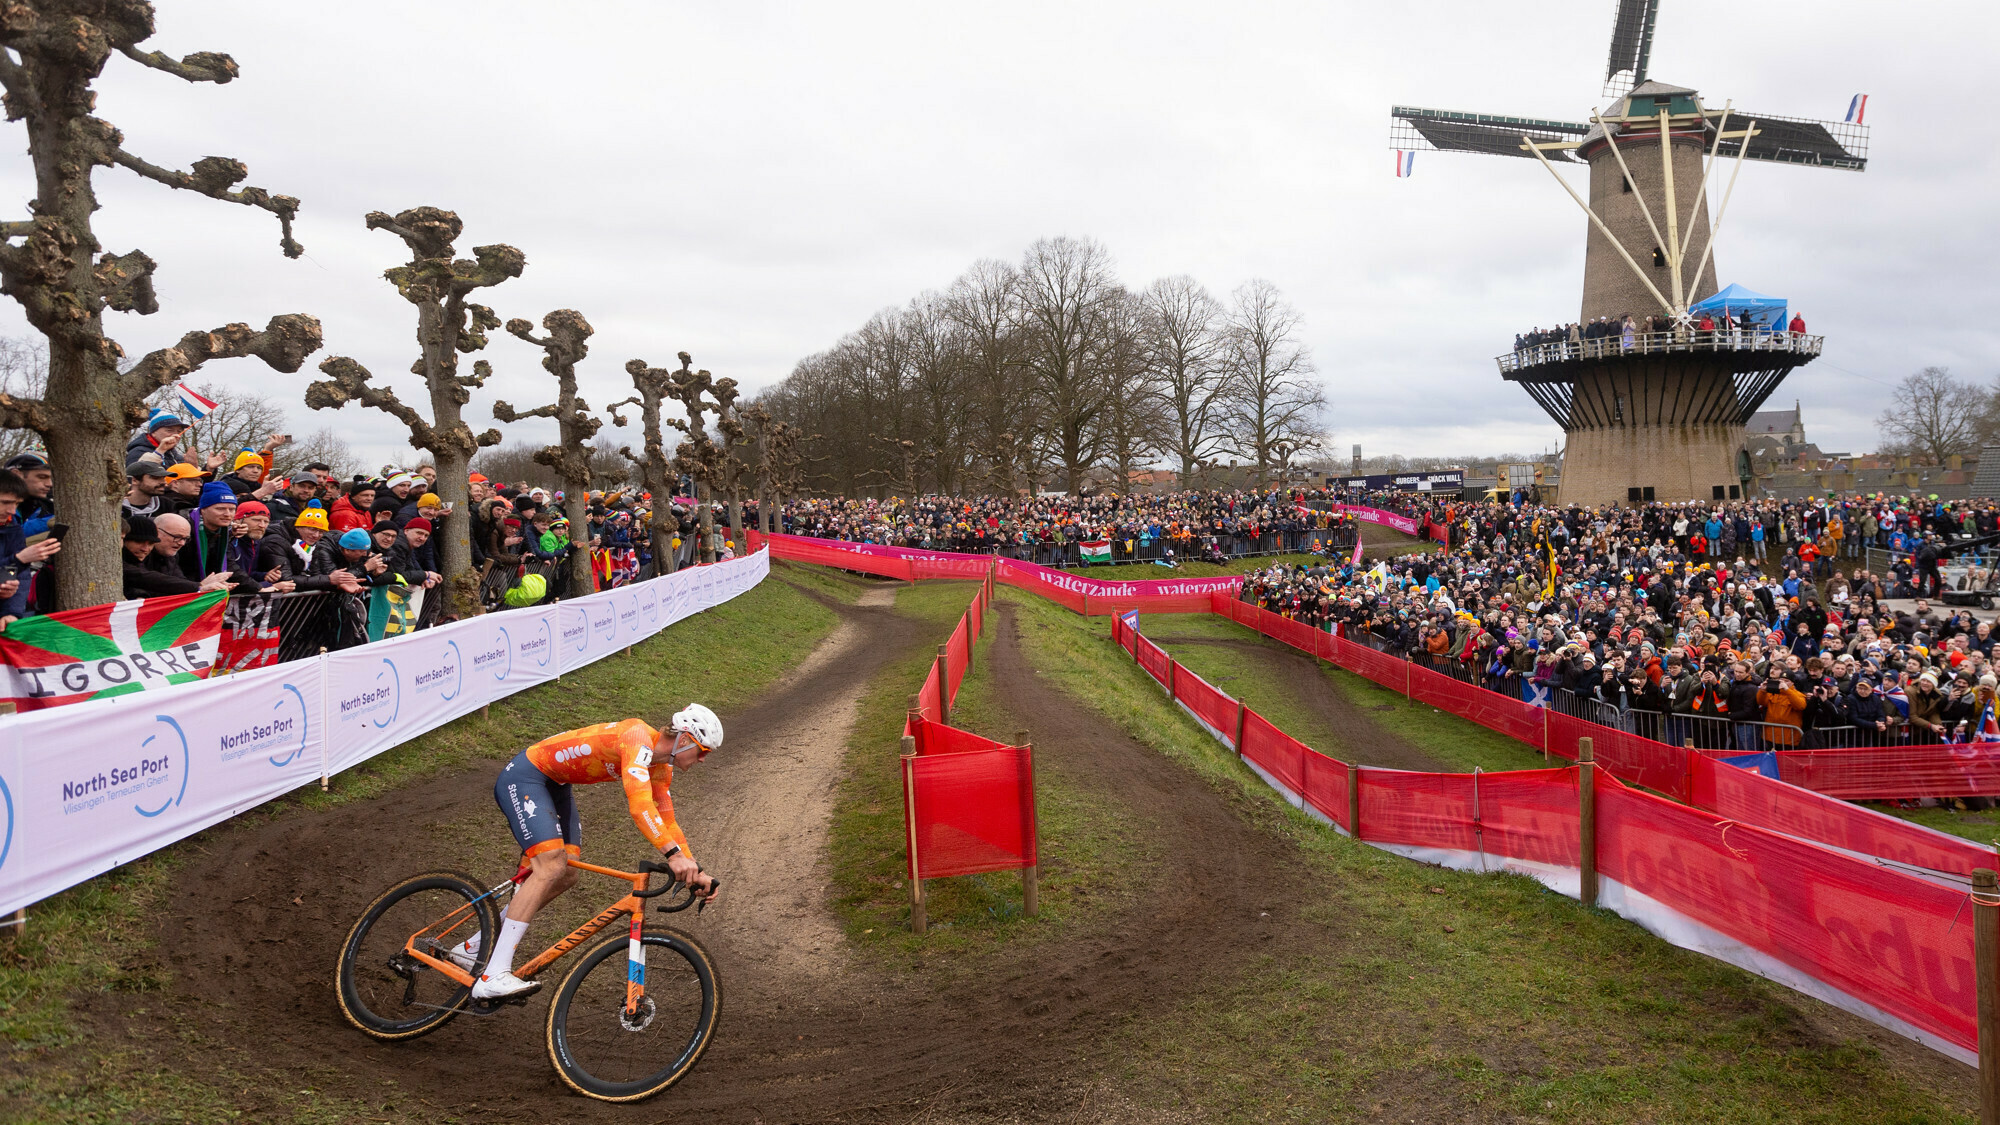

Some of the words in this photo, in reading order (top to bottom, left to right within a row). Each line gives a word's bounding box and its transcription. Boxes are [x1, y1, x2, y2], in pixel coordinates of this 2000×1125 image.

[1348, 479, 1367, 487] DRINKS
[1396, 476, 1420, 484] BURGERS
[1427, 474, 1446, 483] SNACK
[1446, 474, 1461, 482] WALL
[1039, 571, 1137, 597] waterzande
[1157, 577, 1244, 596] waterzande
[539, 638, 547, 647] Port
[473, 653, 487, 665] North
[487, 651, 496, 661] Sea
[496, 649, 505, 658] Port
[18, 642, 210, 698] IGORRE
[415, 671, 431, 686] North
[432, 668, 442, 680] Sea
[443, 665, 454, 676] Port
[340, 694, 361, 713] North
[362, 690, 375, 704] Sea
[376, 686, 390, 700] Port
[220, 731, 250, 751] North
[252, 723, 271, 741] Sea
[273, 717, 293, 733] Port
[642, 752, 649, 762] 1
[63, 773, 107, 801] North
[110, 766, 138, 786] Sea
[141, 755, 169, 777] Port
[63, 793, 105, 815] Vlissingen
[106, 781, 146, 801] Terneuzen
[146, 773, 169, 788] Ghent
[508, 783, 533, 840] Staatsloterij
[554, 907, 621, 951] CANYON
